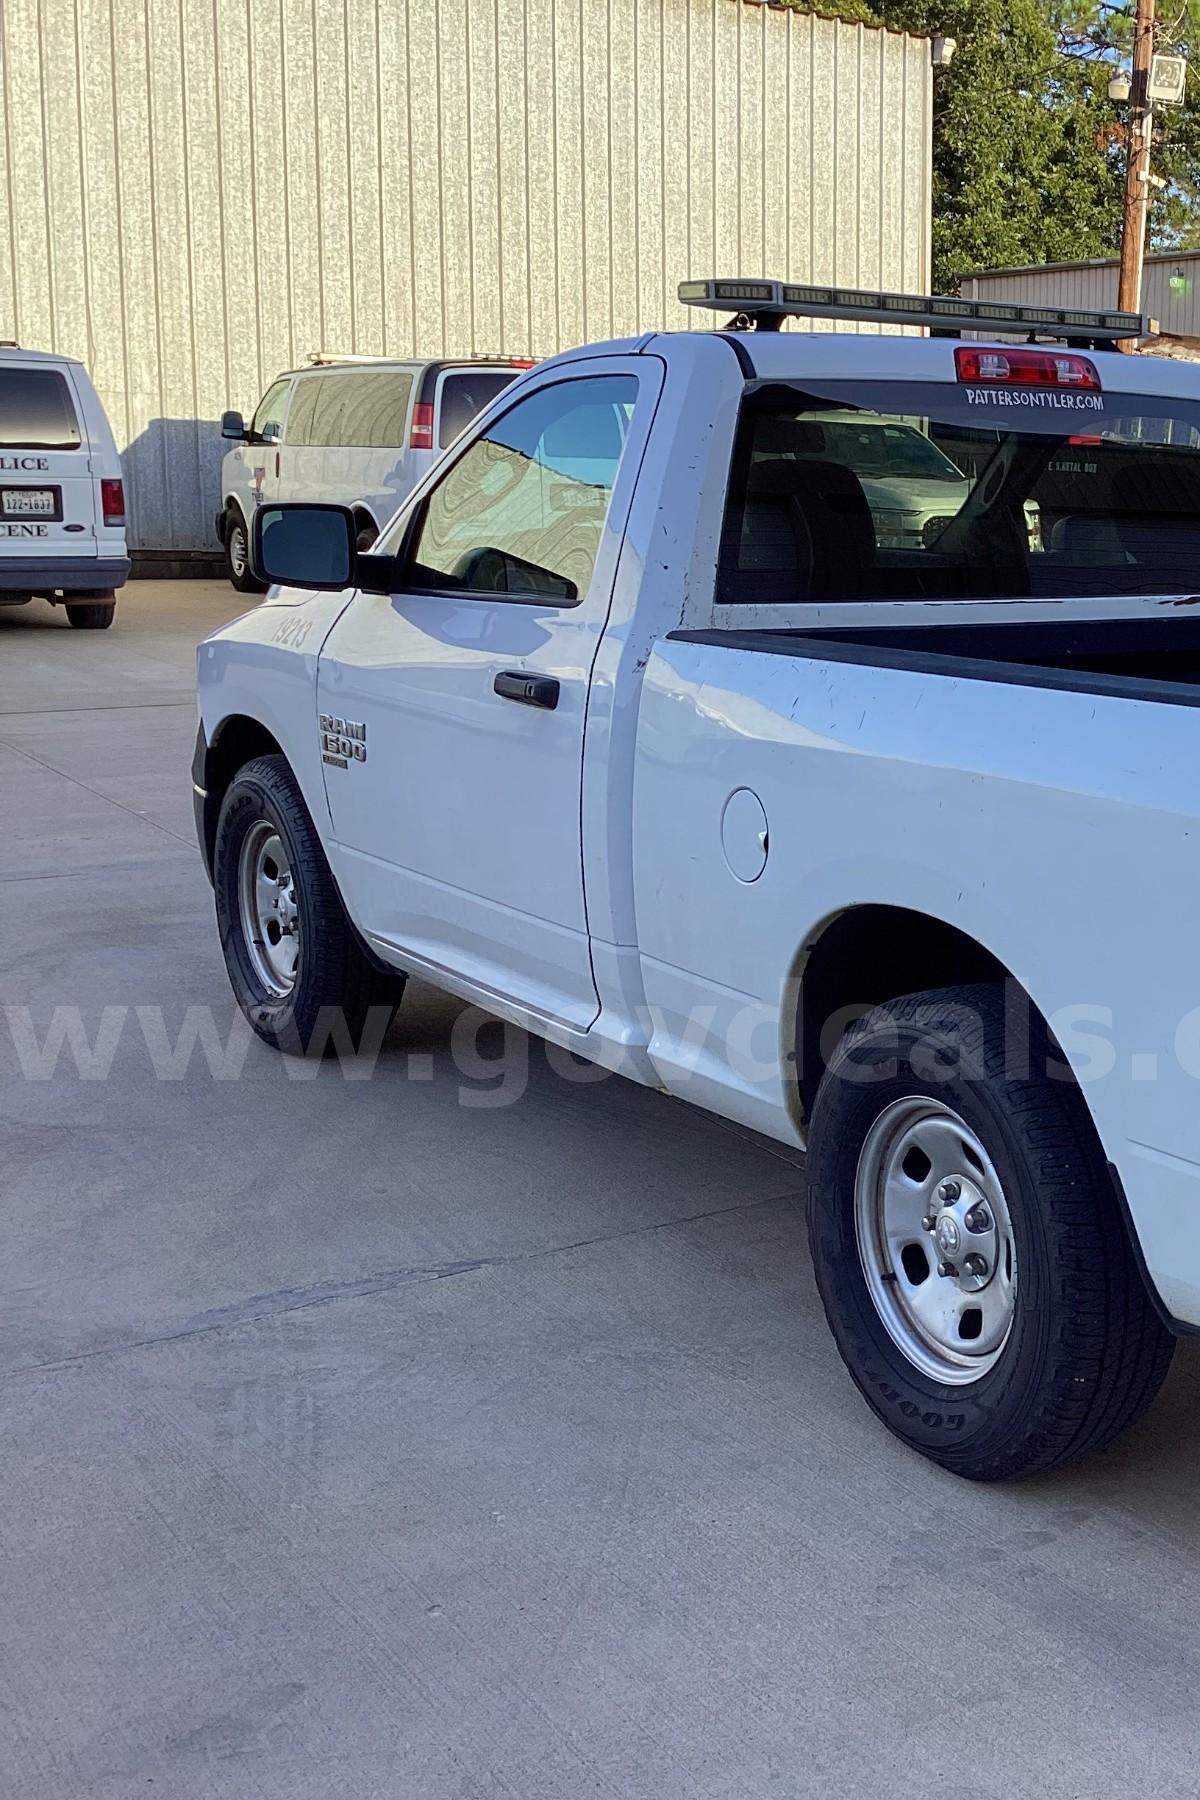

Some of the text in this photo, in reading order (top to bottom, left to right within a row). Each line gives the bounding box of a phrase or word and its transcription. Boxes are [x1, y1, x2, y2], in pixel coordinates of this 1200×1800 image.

[966, 389, 1104, 411] PATTERSONTYLER.COM
[320, 713, 366, 742] RAM
[322, 734, 367, 763] 1500
